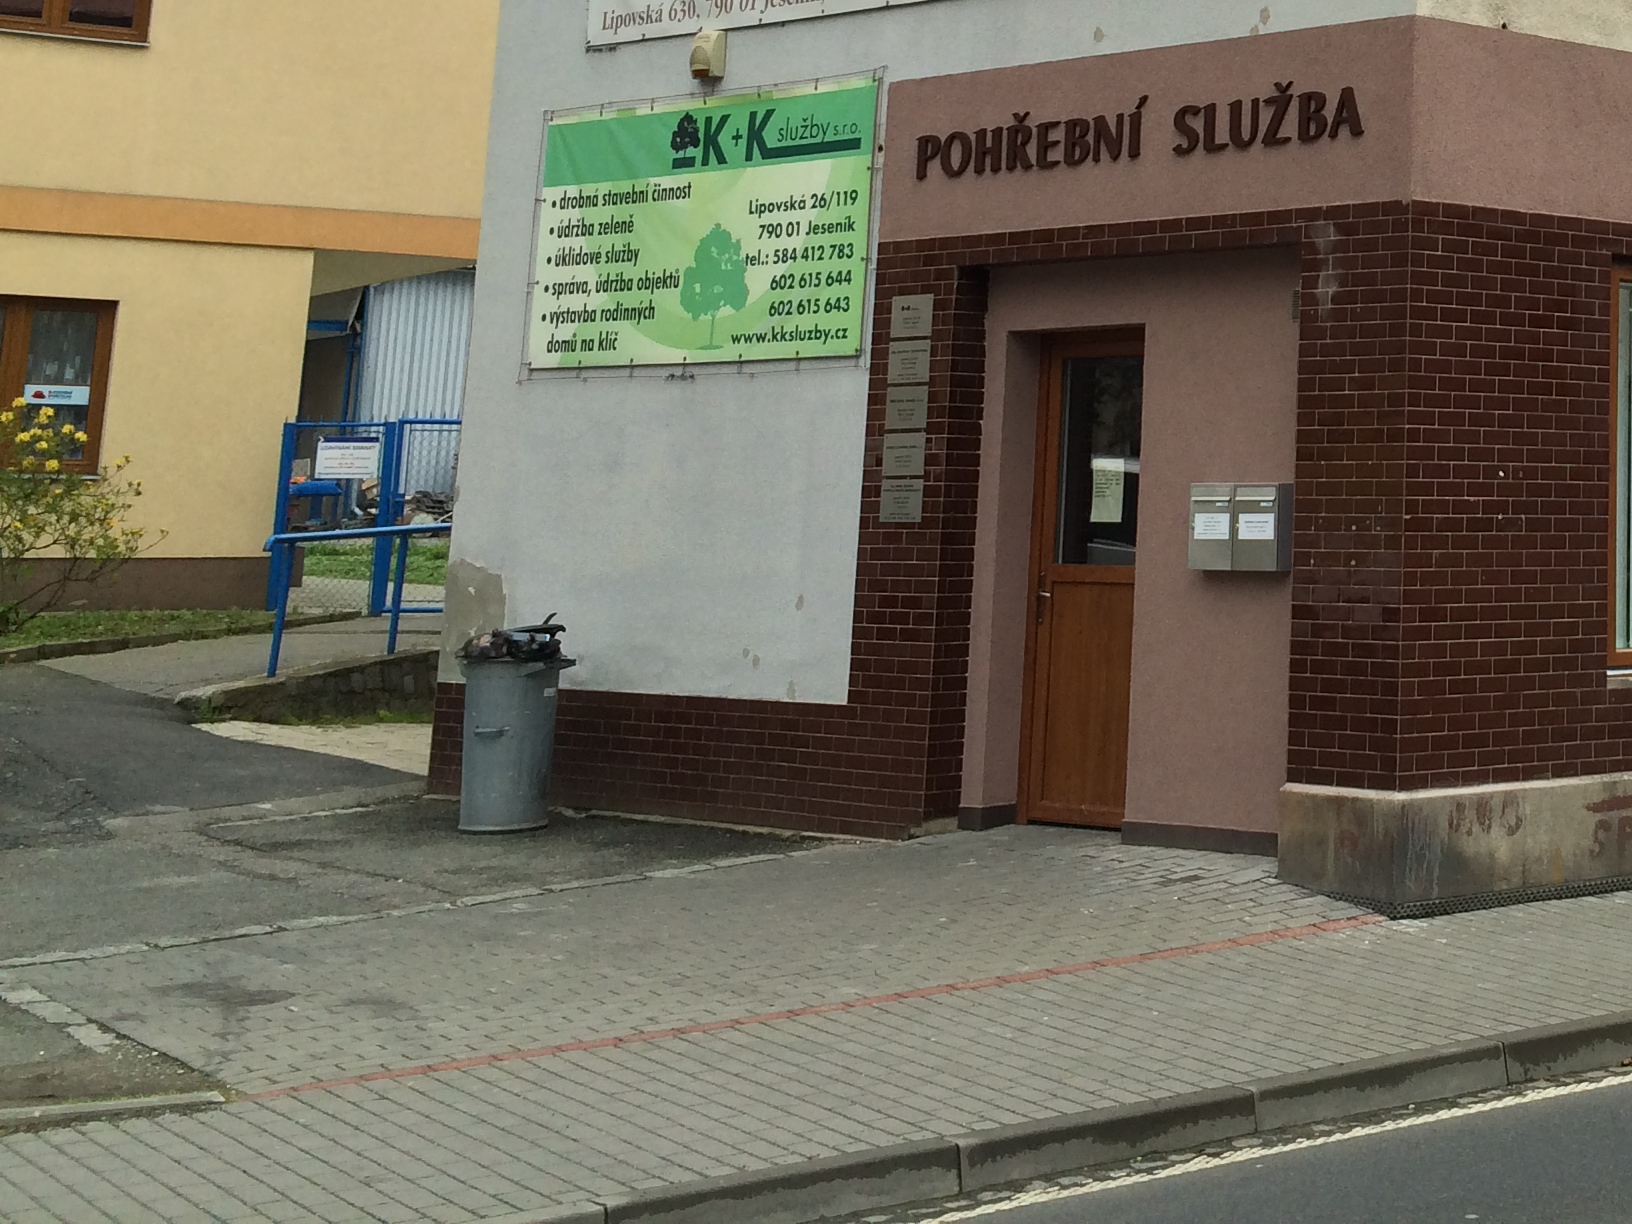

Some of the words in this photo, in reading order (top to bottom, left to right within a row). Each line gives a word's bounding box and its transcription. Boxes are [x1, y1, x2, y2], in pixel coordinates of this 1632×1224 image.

[602, 3, 663, 35] Lipovská
[777, 114, 830, 143] služby
[915, 94, 1149, 180] POHŘEBNÍ
[1172, 80, 1365, 157] SLUŽBA
[559, 188, 598, 210] drobná
[602, 183, 650, 206] stavební
[652, 181, 692, 202] činnost
[749, 194, 806, 218] Lipovská
[810, 189, 859, 211] 26/119
[557, 216, 594, 238] údržba
[598, 213, 634, 236] zeleně
[758, 223, 783, 240] 790
[786, 221, 800, 238] 01
[805, 215, 856, 236] Jeseník
[554, 245, 602, 267] úklidové
[604, 242, 640, 267] služby
[745, 249, 769, 267] tel.:
[772, 247, 798, 265] 584
[801, 245, 825, 262] 412
[828, 242, 854, 260] 783
[551, 276, 592, 300] správa,
[595, 272, 633, 293] údržba
[637, 268, 681, 295] objektů
[770, 273, 795, 291] 602
[798, 272, 822, 289] 615
[825, 269, 853, 286] 644
[549, 302, 597, 329] výstavba
[600, 299, 655, 325] rodinných
[768, 299, 793, 317] 602
[797, 298, 820, 315] 615
[824, 296, 850, 313] 643
[547, 332, 577, 353] domů
[580, 337, 594, 352] na
[598, 331, 619, 351] klíč
[731, 323, 849, 345] www.kksluzby.cz
